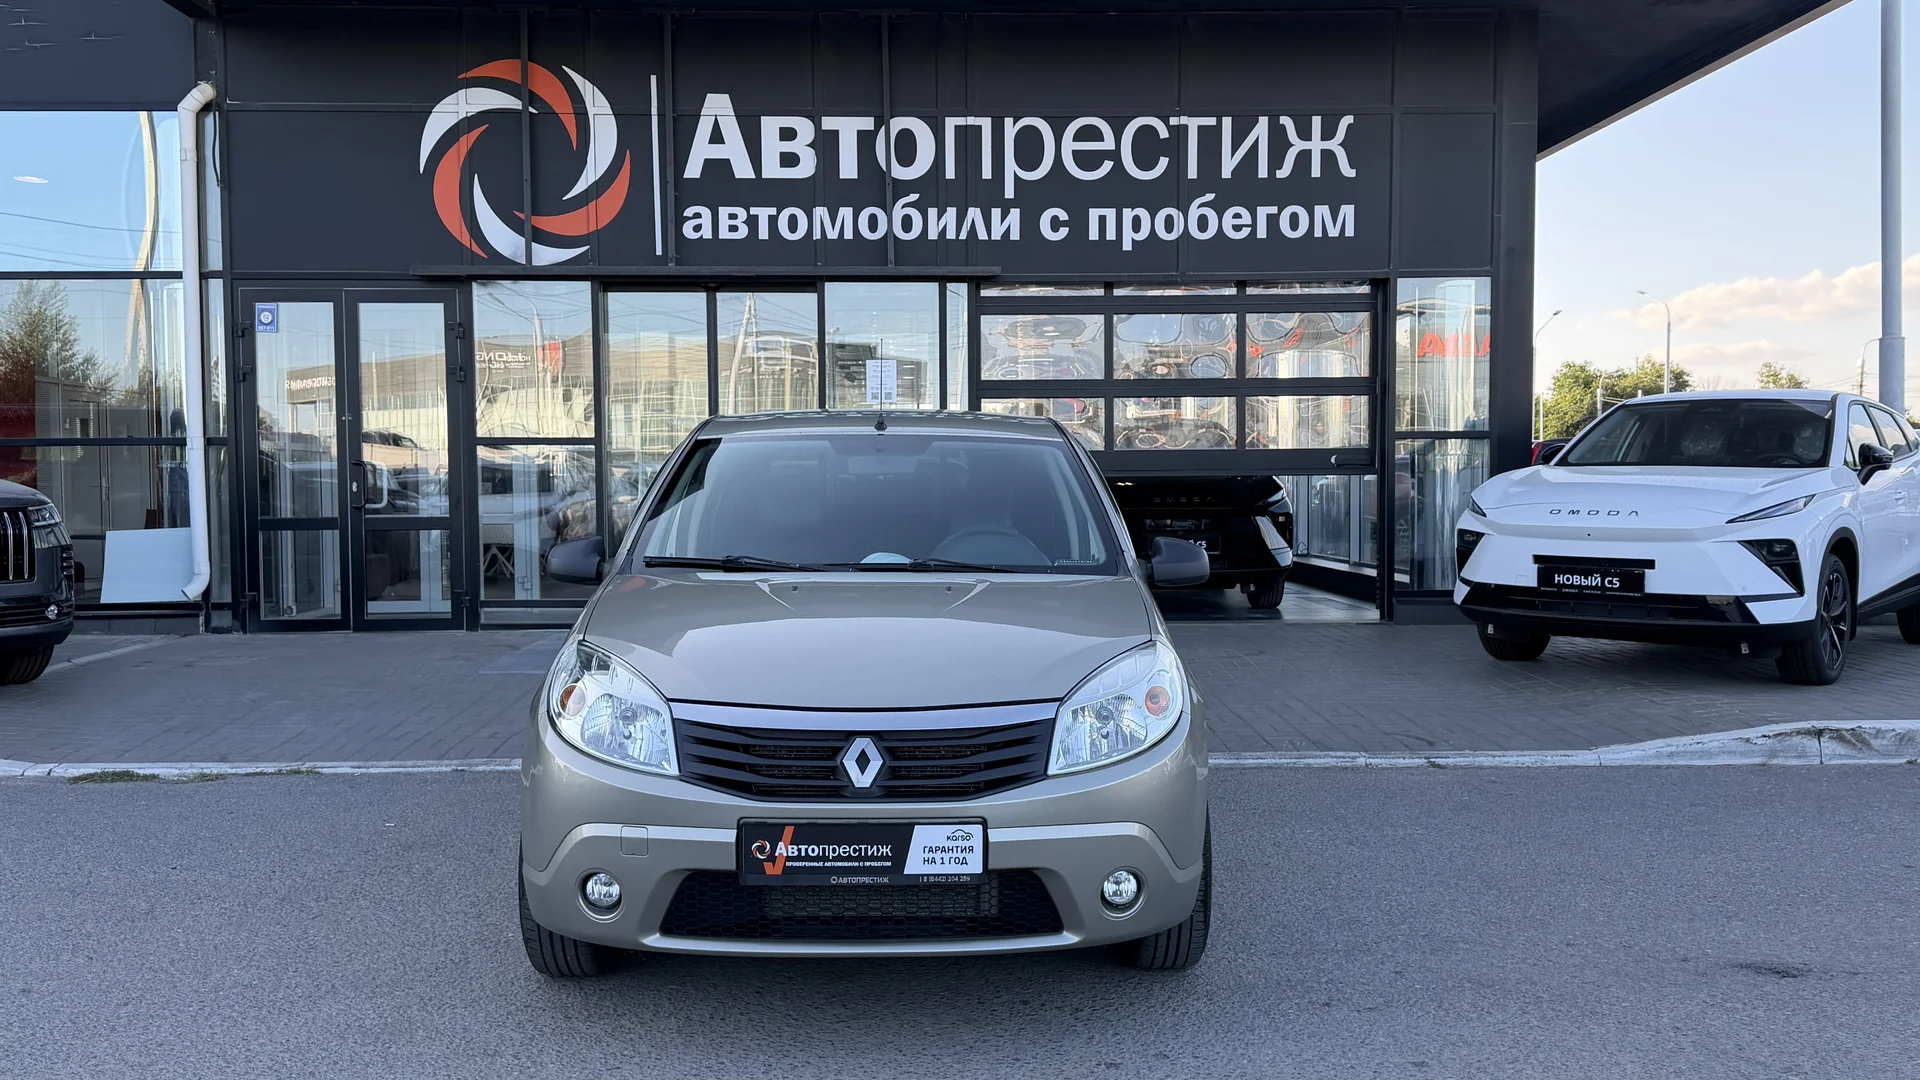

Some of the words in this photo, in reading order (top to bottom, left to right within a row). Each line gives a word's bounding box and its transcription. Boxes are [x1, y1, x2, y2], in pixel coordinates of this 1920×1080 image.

[683, 93, 1357, 199] Автопрестиж
[682, 192, 1021, 241] автомобили
[1039, 207, 1070, 241] с
[1088, 192, 1356, 251] пробегом
[1549, 508, 1640, 517] OMODA
[1554, 573, 1602, 587] НОВЫЙ
[774, 841, 893, 860] Автопрестиж
[922, 845, 974, 854] ГАРАНТИЯ
[922, 856, 937, 865] НА
[939, 856, 946, 865] 1
[948, 856, 969, 866] ГОД
[838, 876, 890, 884] АВТОПРЕСТИЖ
